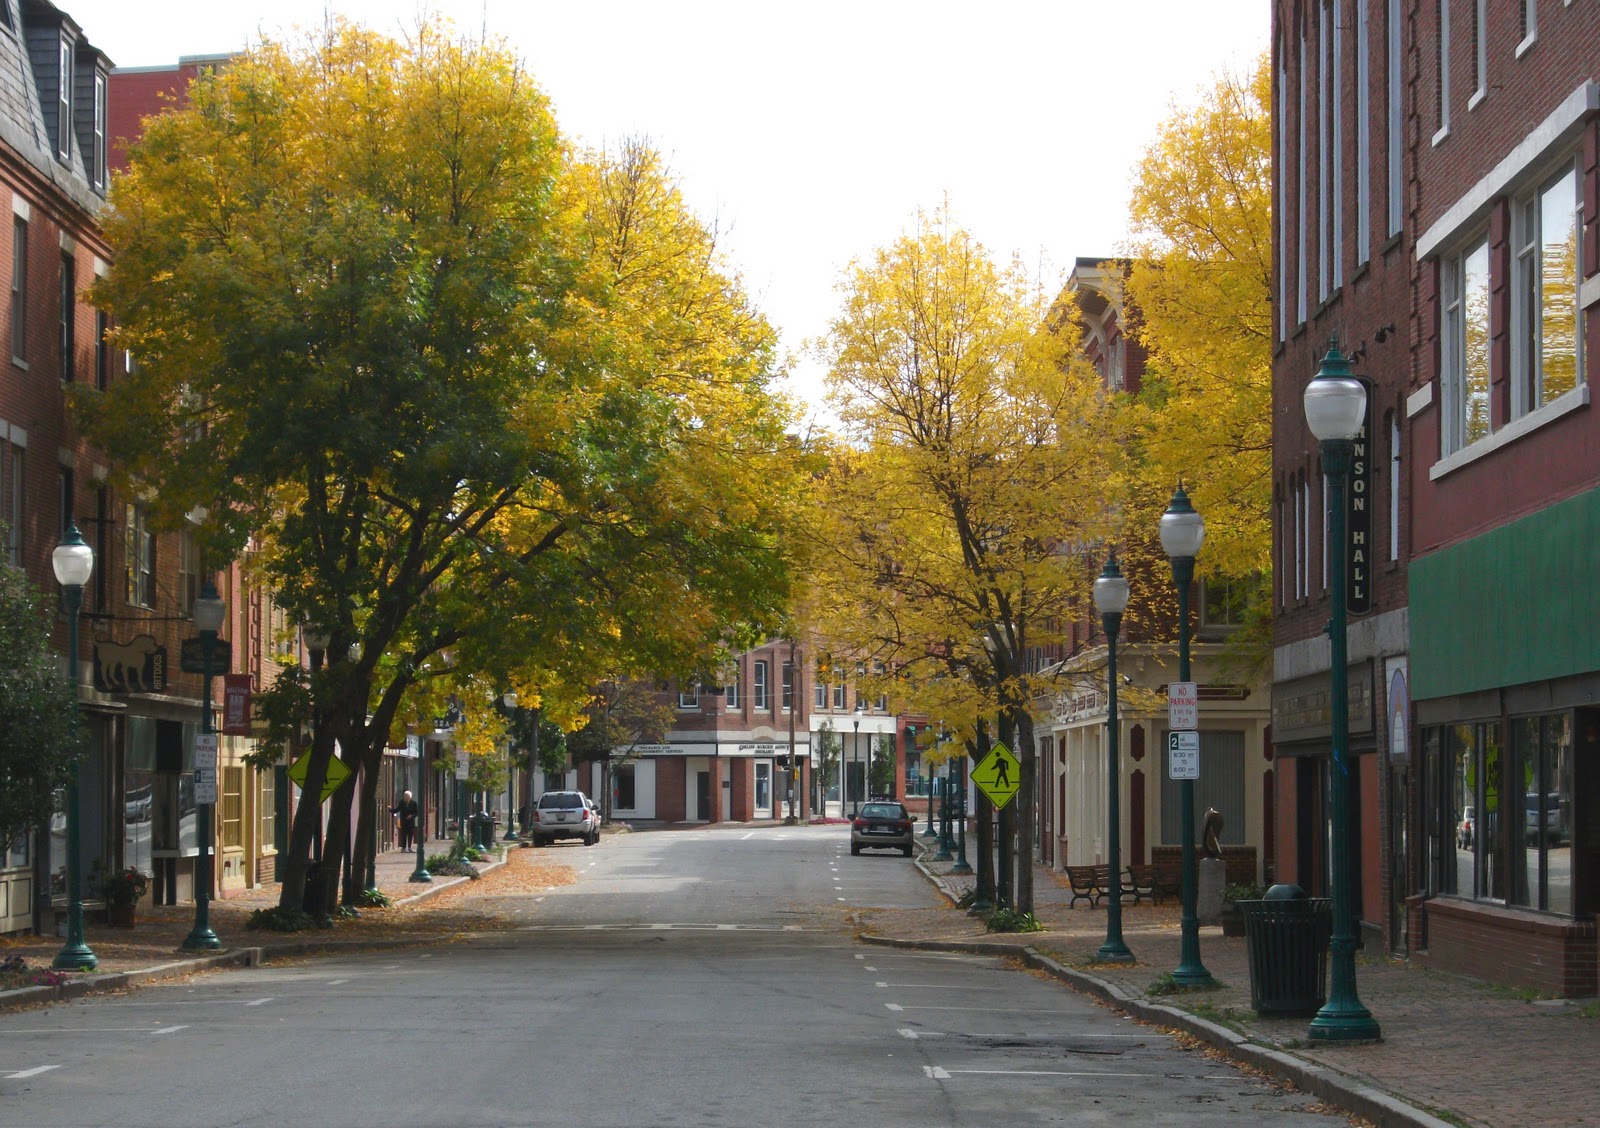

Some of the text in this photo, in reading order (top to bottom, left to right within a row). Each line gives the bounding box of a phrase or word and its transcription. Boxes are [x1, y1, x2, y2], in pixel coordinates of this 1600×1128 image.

[1353, 532, 1365, 599] HALL
[153, 654, 162, 690] ARTDOGS
[1178, 688, 1187, 696] NO
[1170, 698, 1196, 706] PARKING
[1171, 737, 1178, 748] 2
